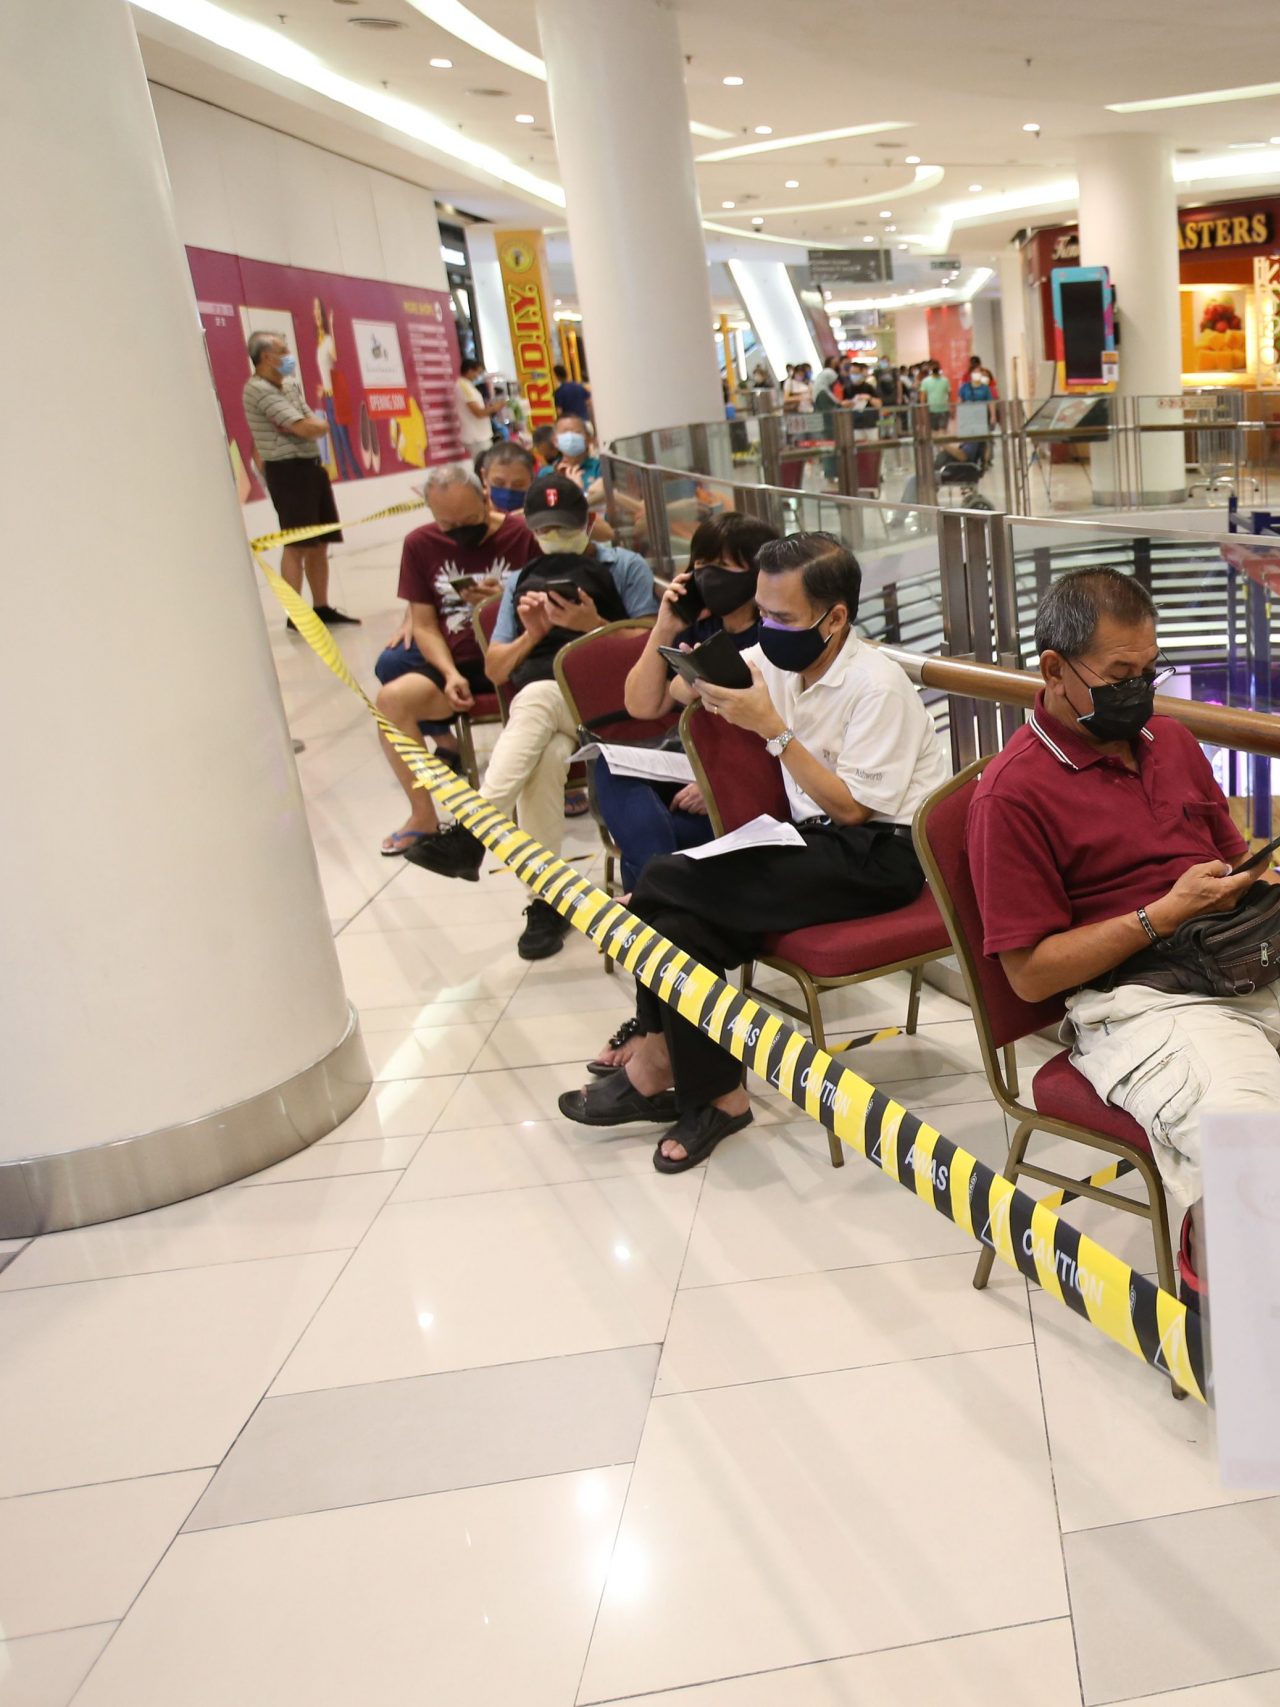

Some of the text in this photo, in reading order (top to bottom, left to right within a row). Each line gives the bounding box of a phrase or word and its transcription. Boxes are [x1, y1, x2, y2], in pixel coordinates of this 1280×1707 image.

[855, 768, 883, 782] Ashworth
[727, 1014, 760, 1047] AWAS
[800, 1067, 853, 1118] CAUTION
[904, 1143, 949, 1191] AWAS
[1022, 1228, 1105, 1309] CAUTION
